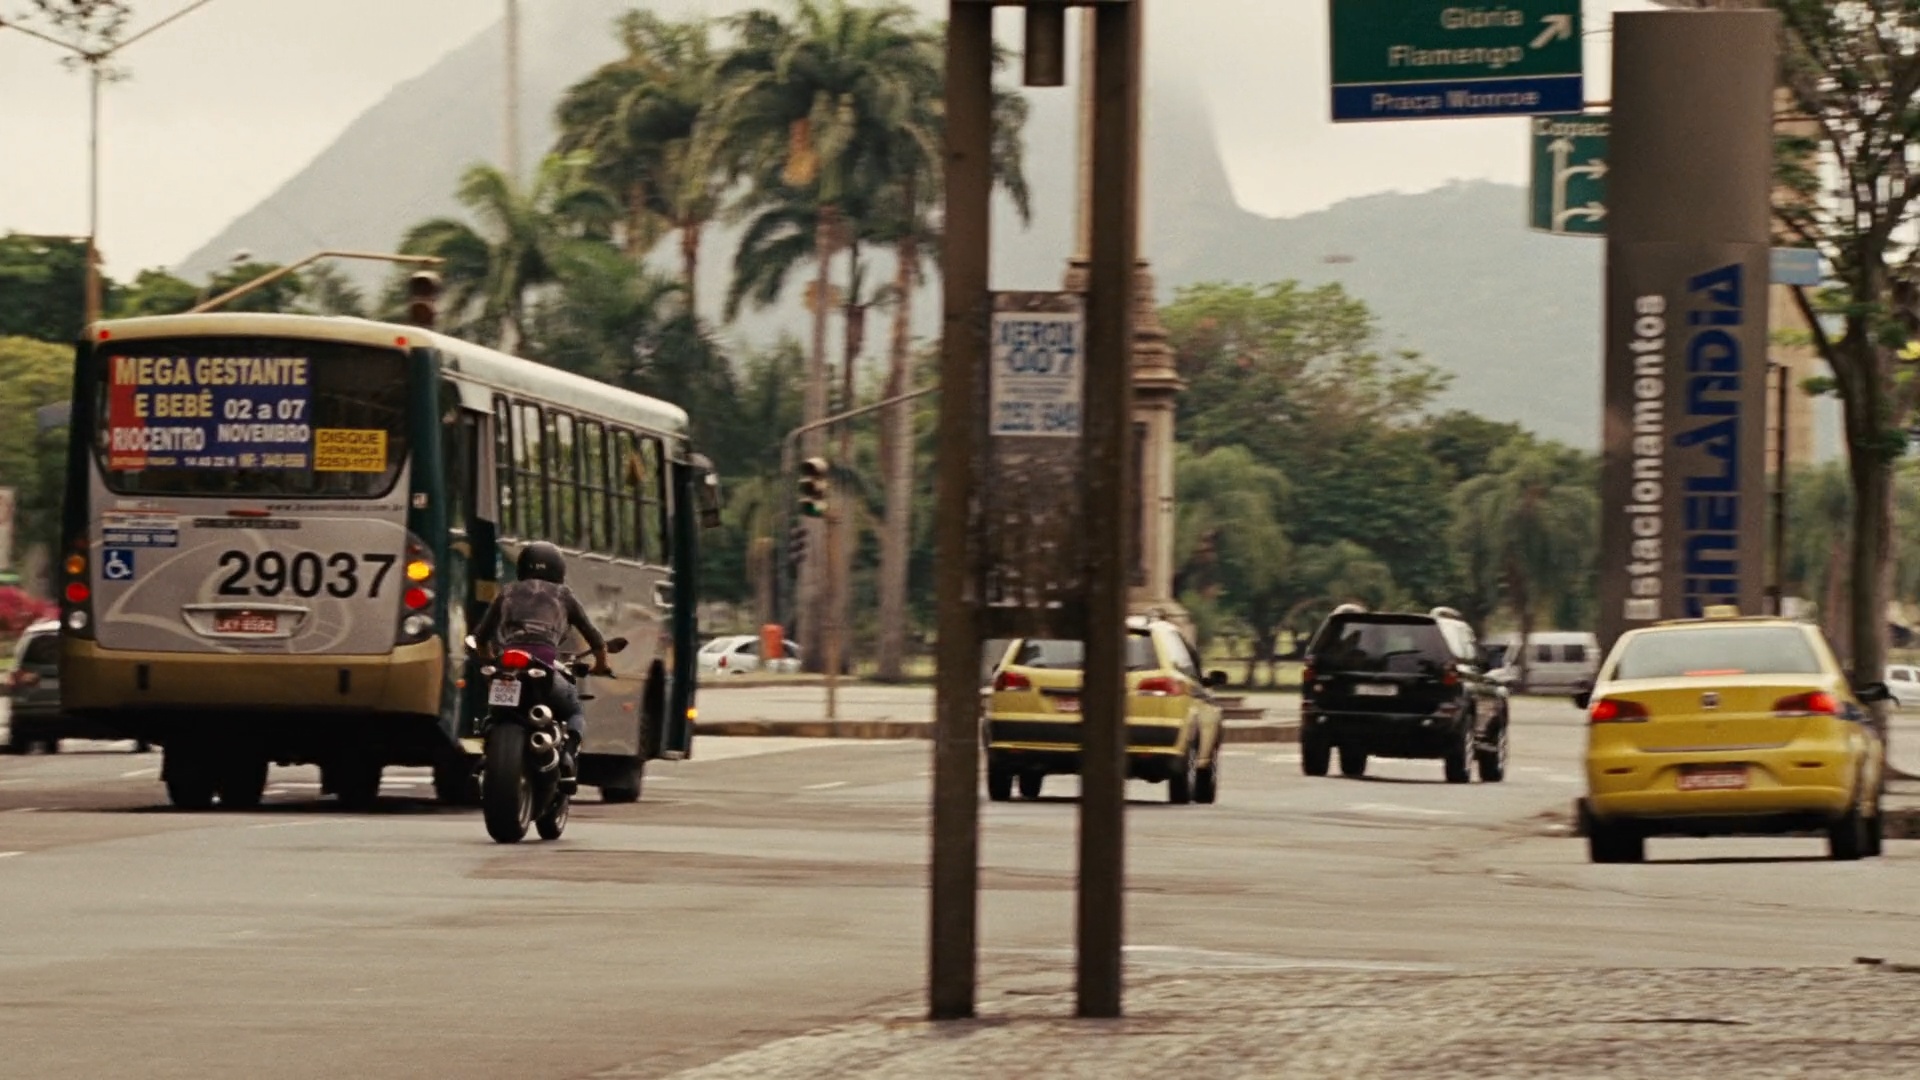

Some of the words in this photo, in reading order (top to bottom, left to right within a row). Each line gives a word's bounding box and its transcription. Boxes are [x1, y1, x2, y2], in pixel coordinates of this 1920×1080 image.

[1387, 44, 1525, 69] Flamengo
[1533, 117, 1611, 138] Copac
[115, 358, 191, 385] MEGA
[195, 358, 307, 385] GESTANTE
[135, 394, 149, 417] E
[155, 388, 213, 417] BEBÊ
[224, 399, 253, 420] 02
[257, 403, 273, 420] a
[277, 399, 306, 420] 07
[112, 427, 206, 451] RIOCENTRO
[217, 424, 310, 443] NOVEMBRO
[320, 432, 380, 444] DISQUE
[1624, 294, 1666, 620] Estacionamentos
[218, 549, 398, 599] 29037
